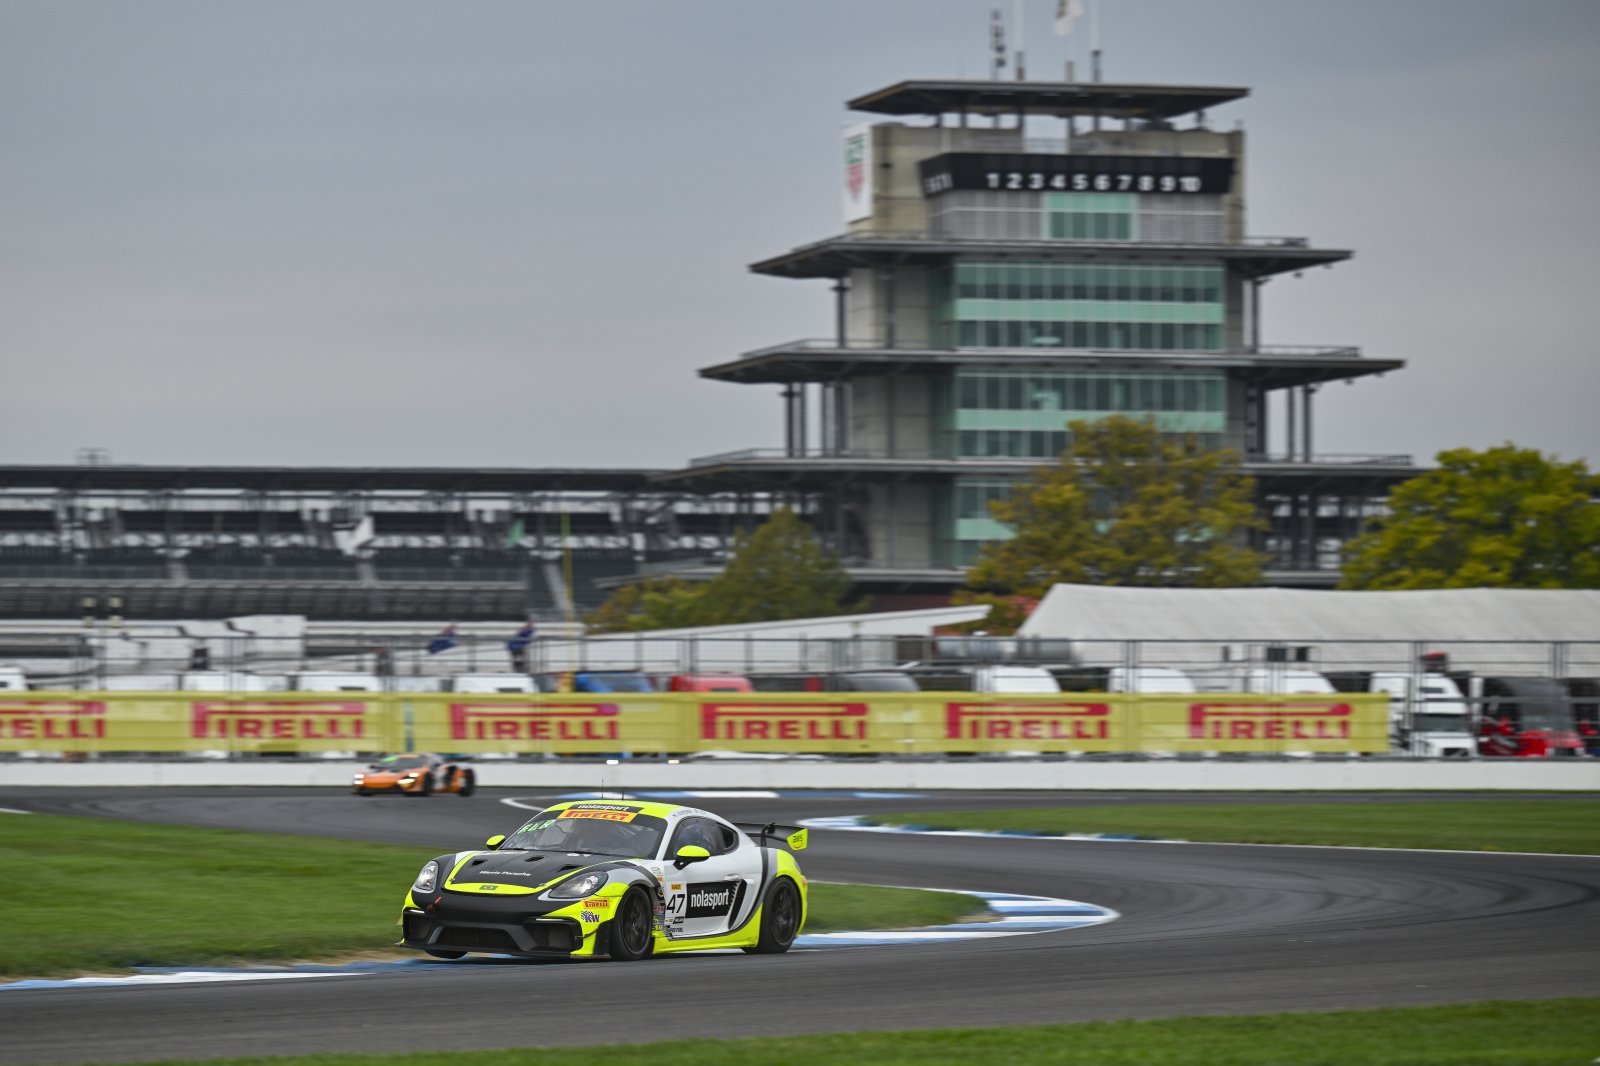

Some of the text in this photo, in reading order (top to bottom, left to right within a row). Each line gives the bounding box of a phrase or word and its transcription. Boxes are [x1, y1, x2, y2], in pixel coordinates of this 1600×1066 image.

[986, 172, 1000, 188] 1
[1006, 172, 1022, 189] 2
[1028, 173, 1045, 189] 3
[1049, 173, 1066, 189] 4
[1072, 173, 1089, 190] 5
[1094, 174, 1111, 190] 6
[1116, 174, 1133, 190] 7
[1138, 175, 1154, 191] 8
[1160, 176, 1176, 192] 9
[192, 702, 367, 738] PIRELLI
[449, 703, 618, 739] PIRELLI
[701, 703, 868, 739] PIRELLI
[946, 703, 1109, 739] PIRELLI
[1189, 703, 1352, 739] PIRELLI
[564, 810, 630, 821] PIRELLI
[584, 899, 609, 908] PIRELLI
[666, 893, 686, 914] 47
[690, 888, 729, 910] nolasport
